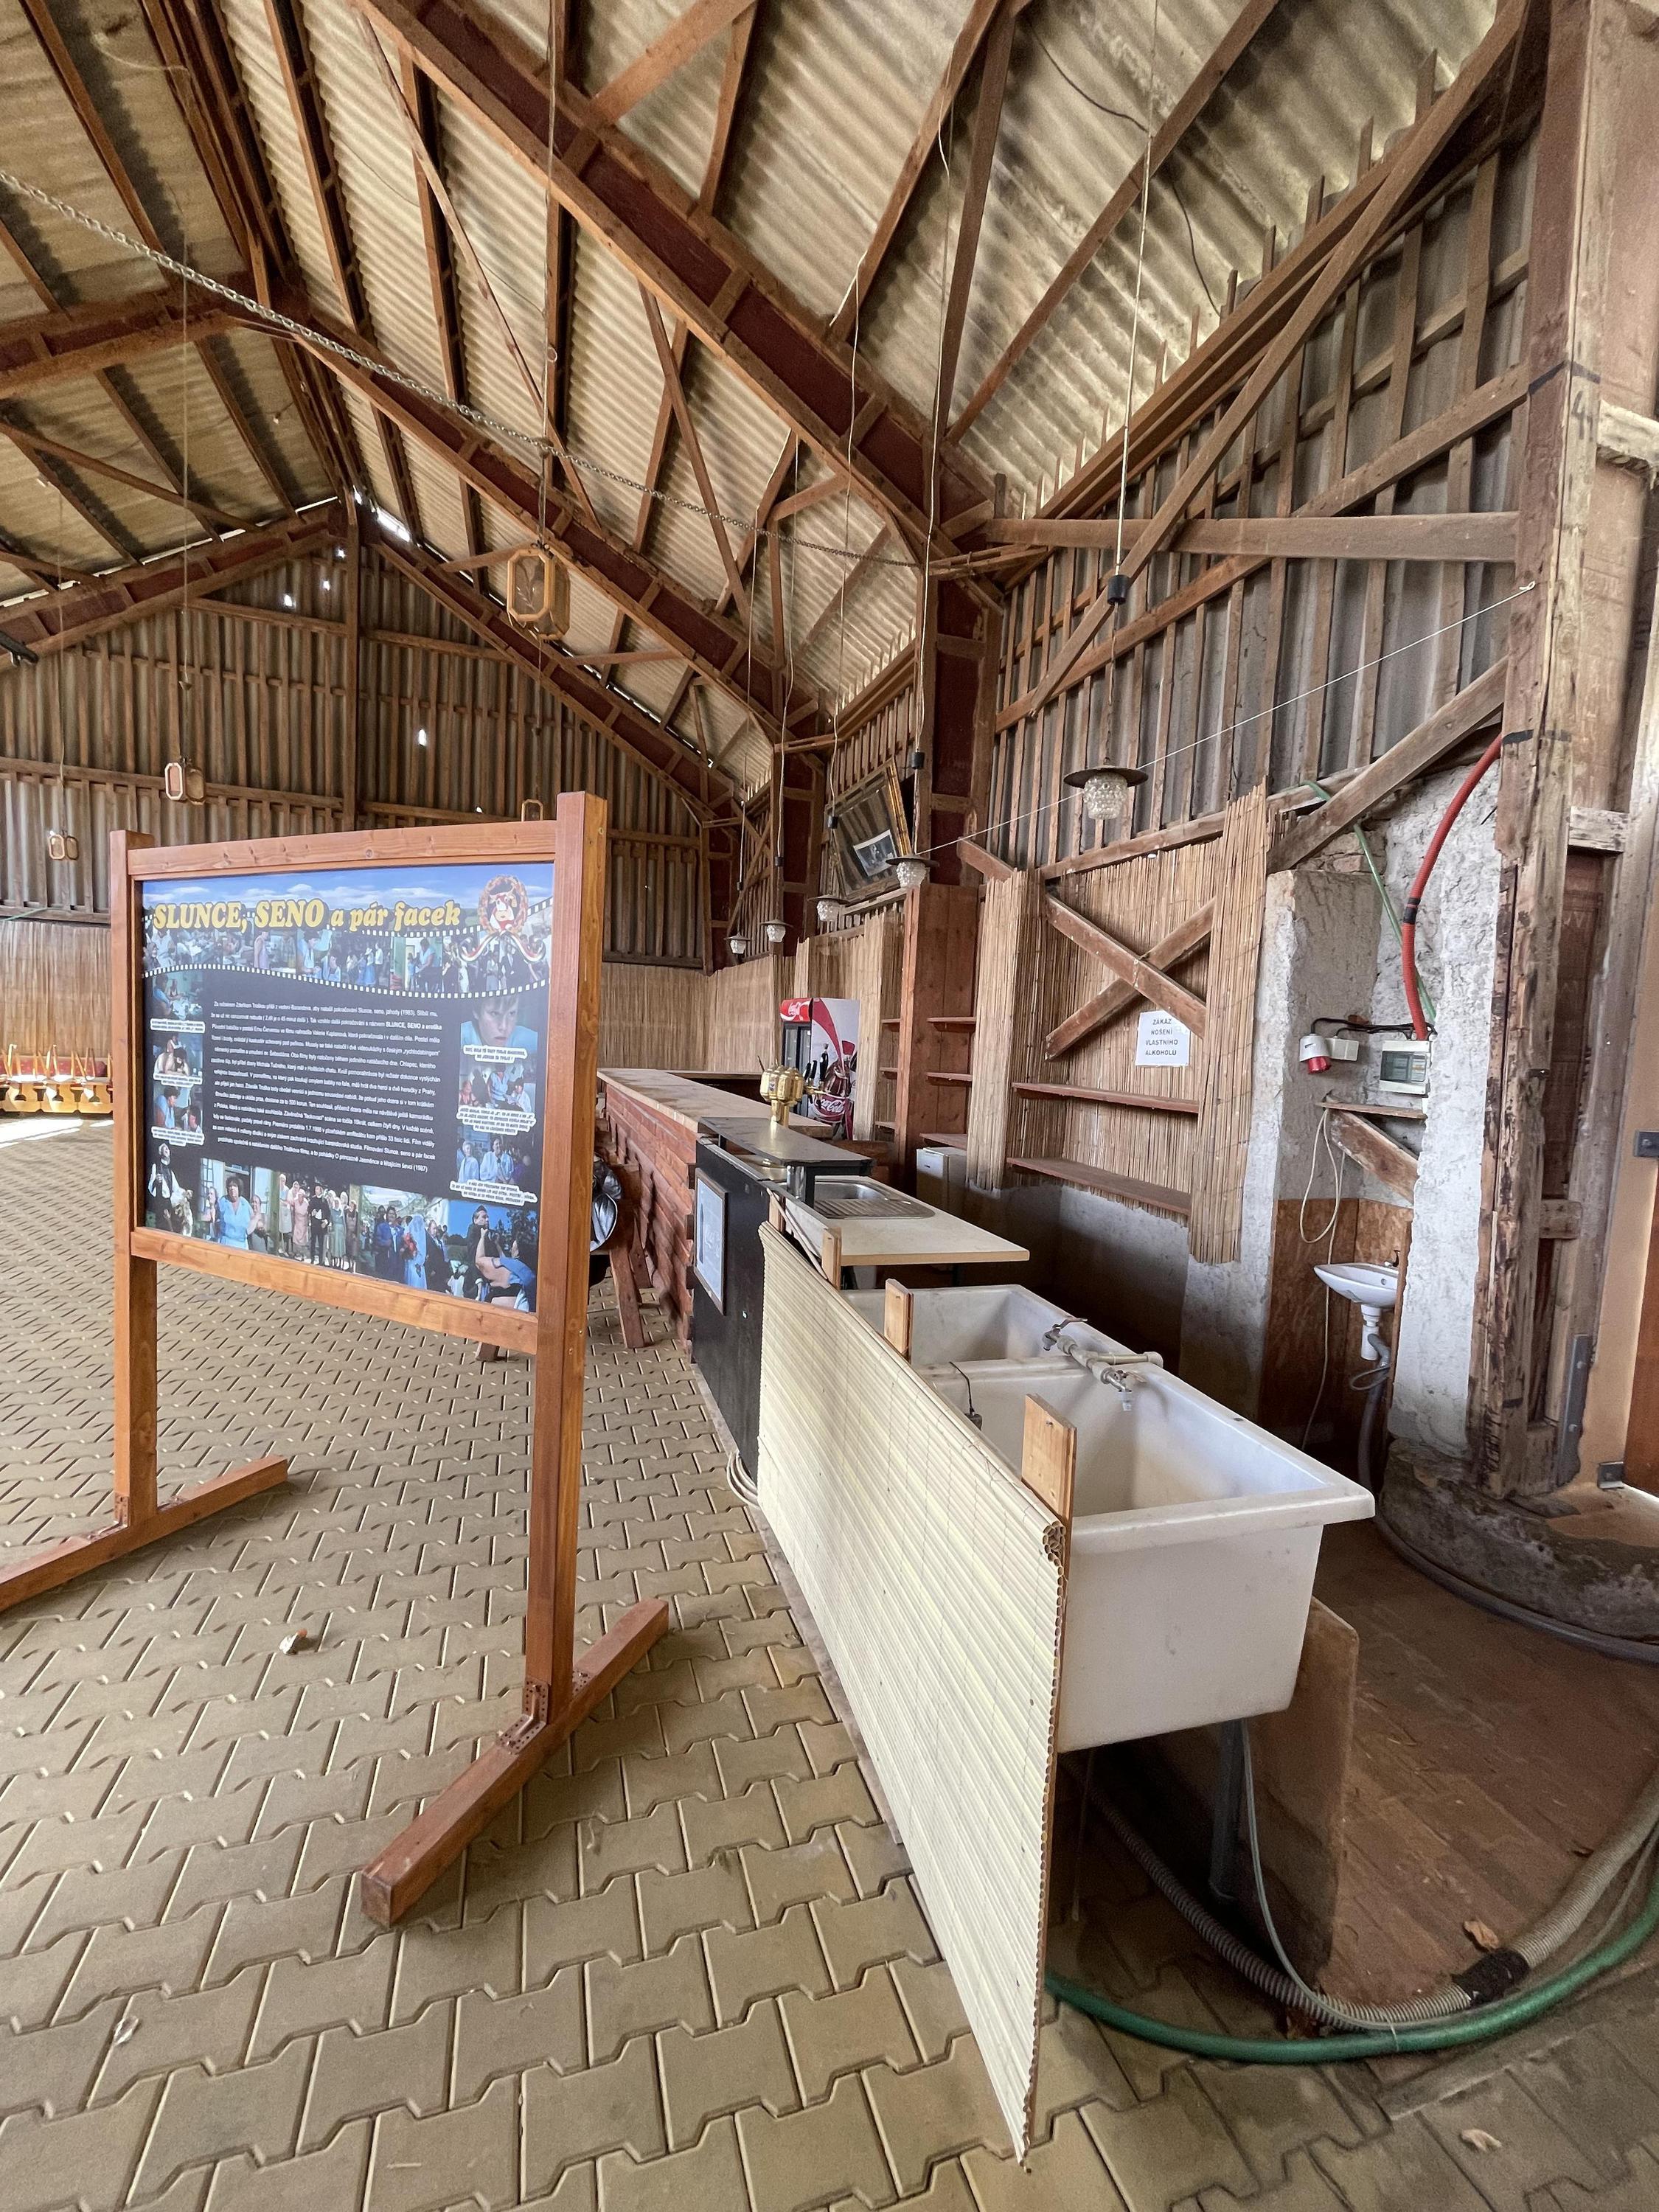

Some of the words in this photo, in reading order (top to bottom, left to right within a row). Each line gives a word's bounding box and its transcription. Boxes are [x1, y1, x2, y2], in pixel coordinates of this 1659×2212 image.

[153, 902, 247, 933] SLUNCE,
[254, 900, 324, 928] SENO
[331, 911, 344, 927] a
[349, 902, 388, 932] pár
[394, 900, 461, 932] facek
